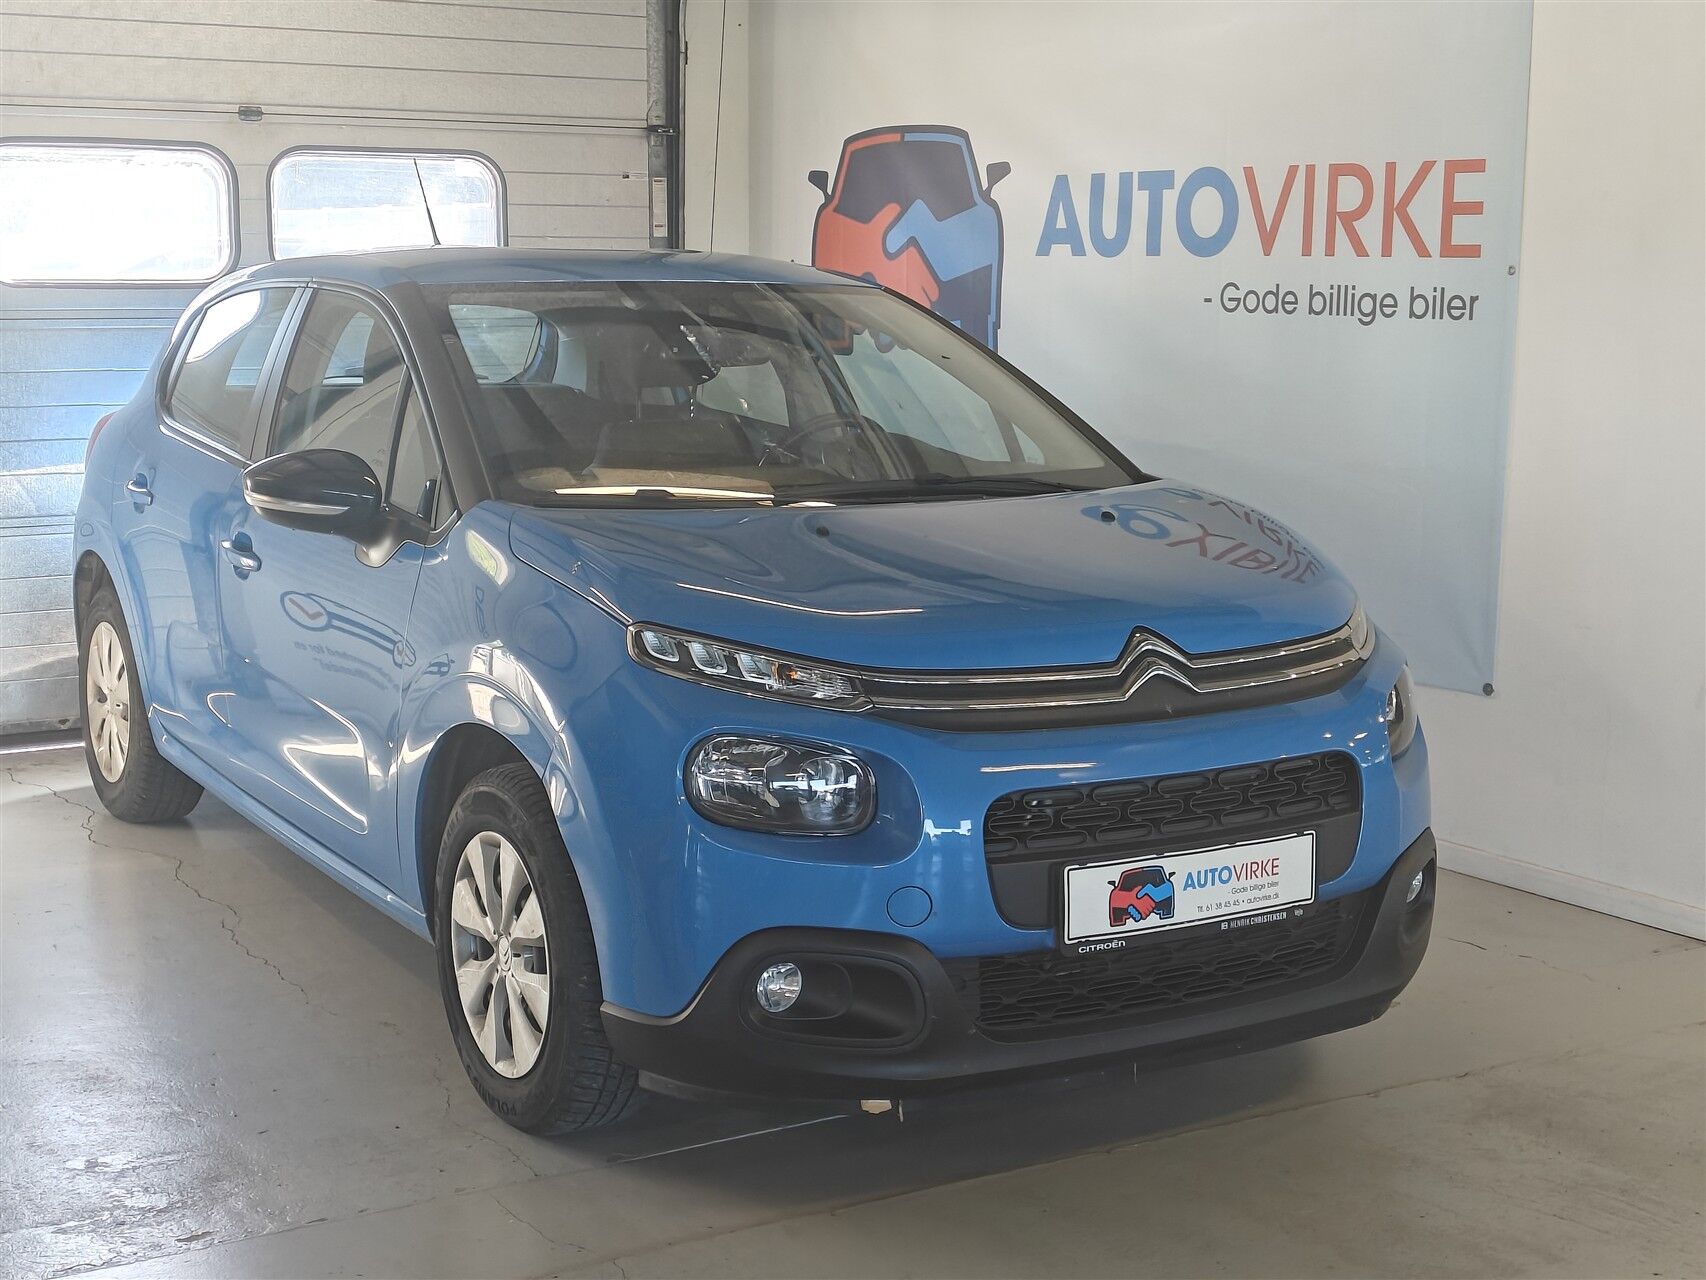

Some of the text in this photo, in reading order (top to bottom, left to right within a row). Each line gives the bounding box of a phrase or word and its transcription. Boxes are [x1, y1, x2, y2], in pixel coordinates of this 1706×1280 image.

[1035, 158, 1487, 259] AUTOVIRKE
[1219, 281, 1299, 316] Gode
[1307, 283, 1398, 326] billige
[1408, 286, 1479, 321] biler
[1183, 858, 1280, 891] AUTOVIRKE
[1205, 903, 1213, 911] 61
[1215, 901, 1223, 911] 38
[1078, 940, 1126, 953] CITROËN
